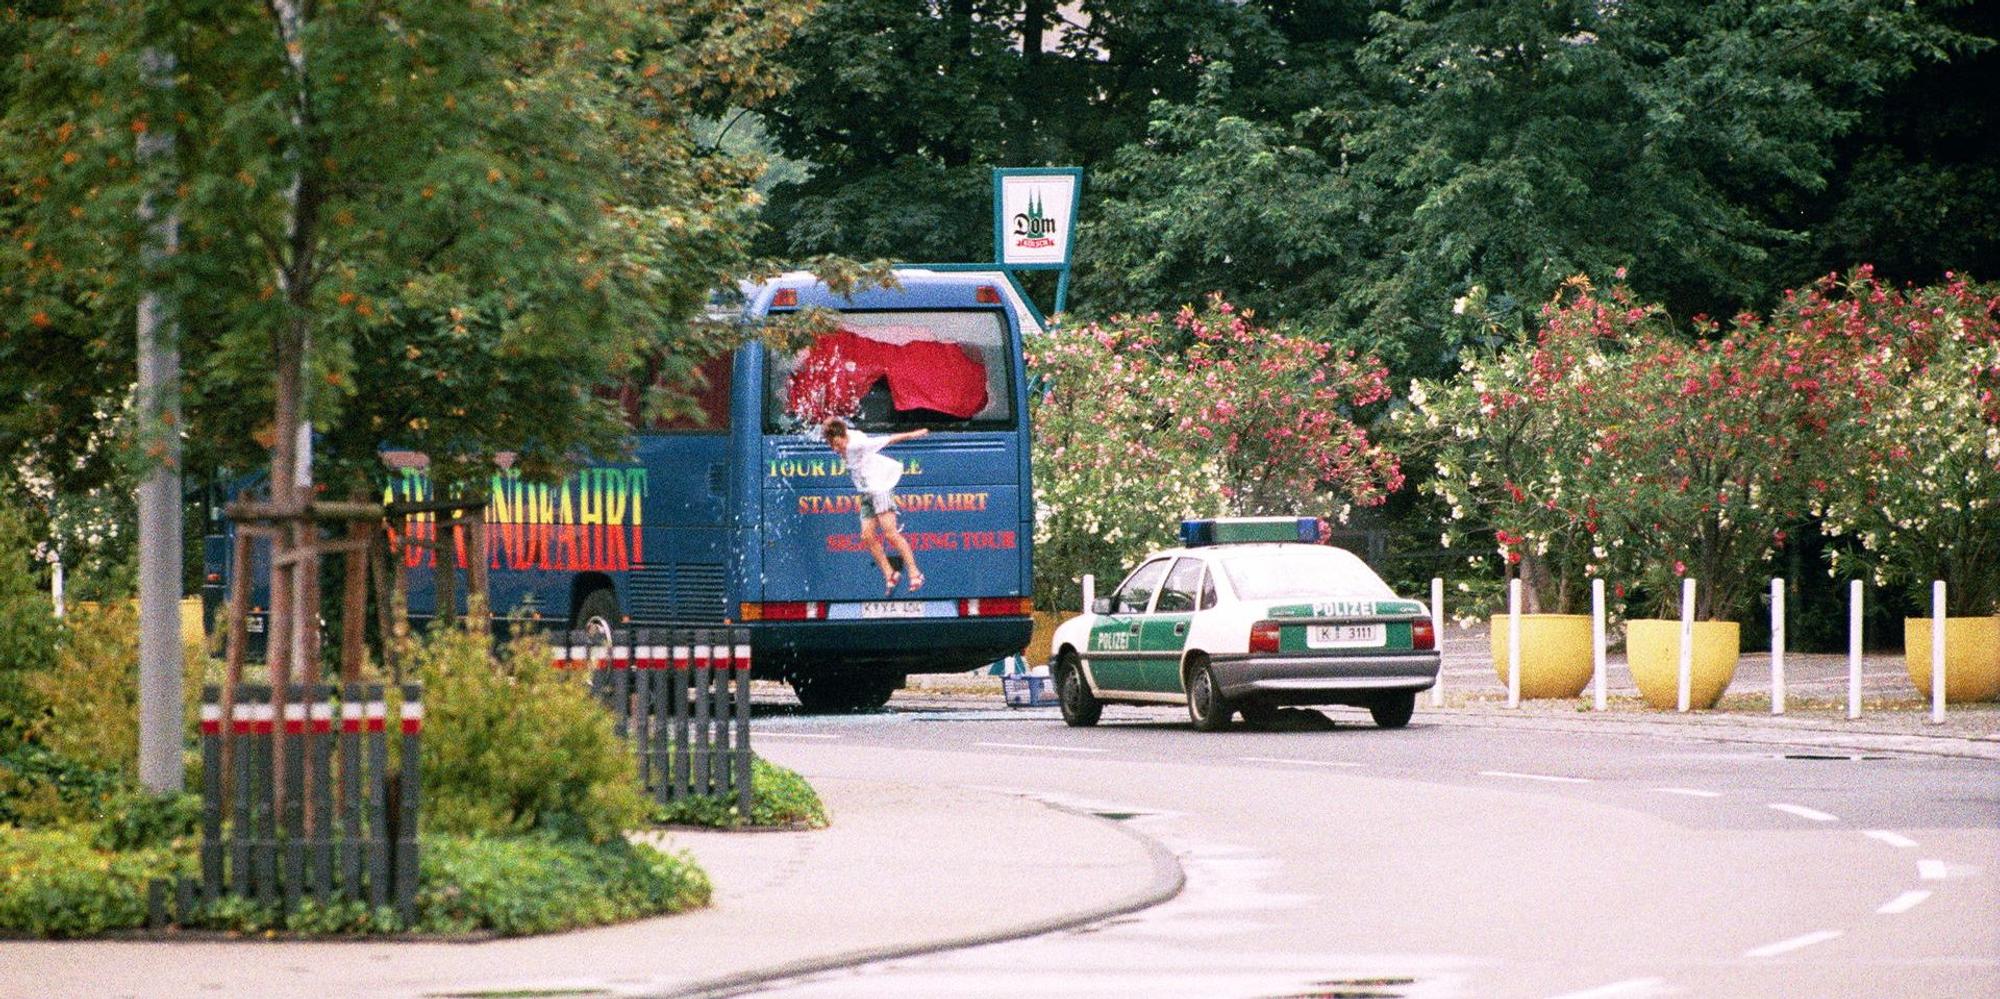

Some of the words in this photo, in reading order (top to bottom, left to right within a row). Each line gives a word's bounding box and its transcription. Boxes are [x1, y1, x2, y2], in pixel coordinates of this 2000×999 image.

[1013, 213, 1056, 235] Dom
[768, 458, 826, 477] TOUR
[798, 493, 988, 514] STADTNDFAHRT
[962, 530, 1017, 550] TOUR
[1312, 601, 1376, 617] POLIZEI
[1098, 631, 1129, 650] POLIZEI
[1321, 628, 1330, 639] K
[1349, 627, 1372, 639] 3111
